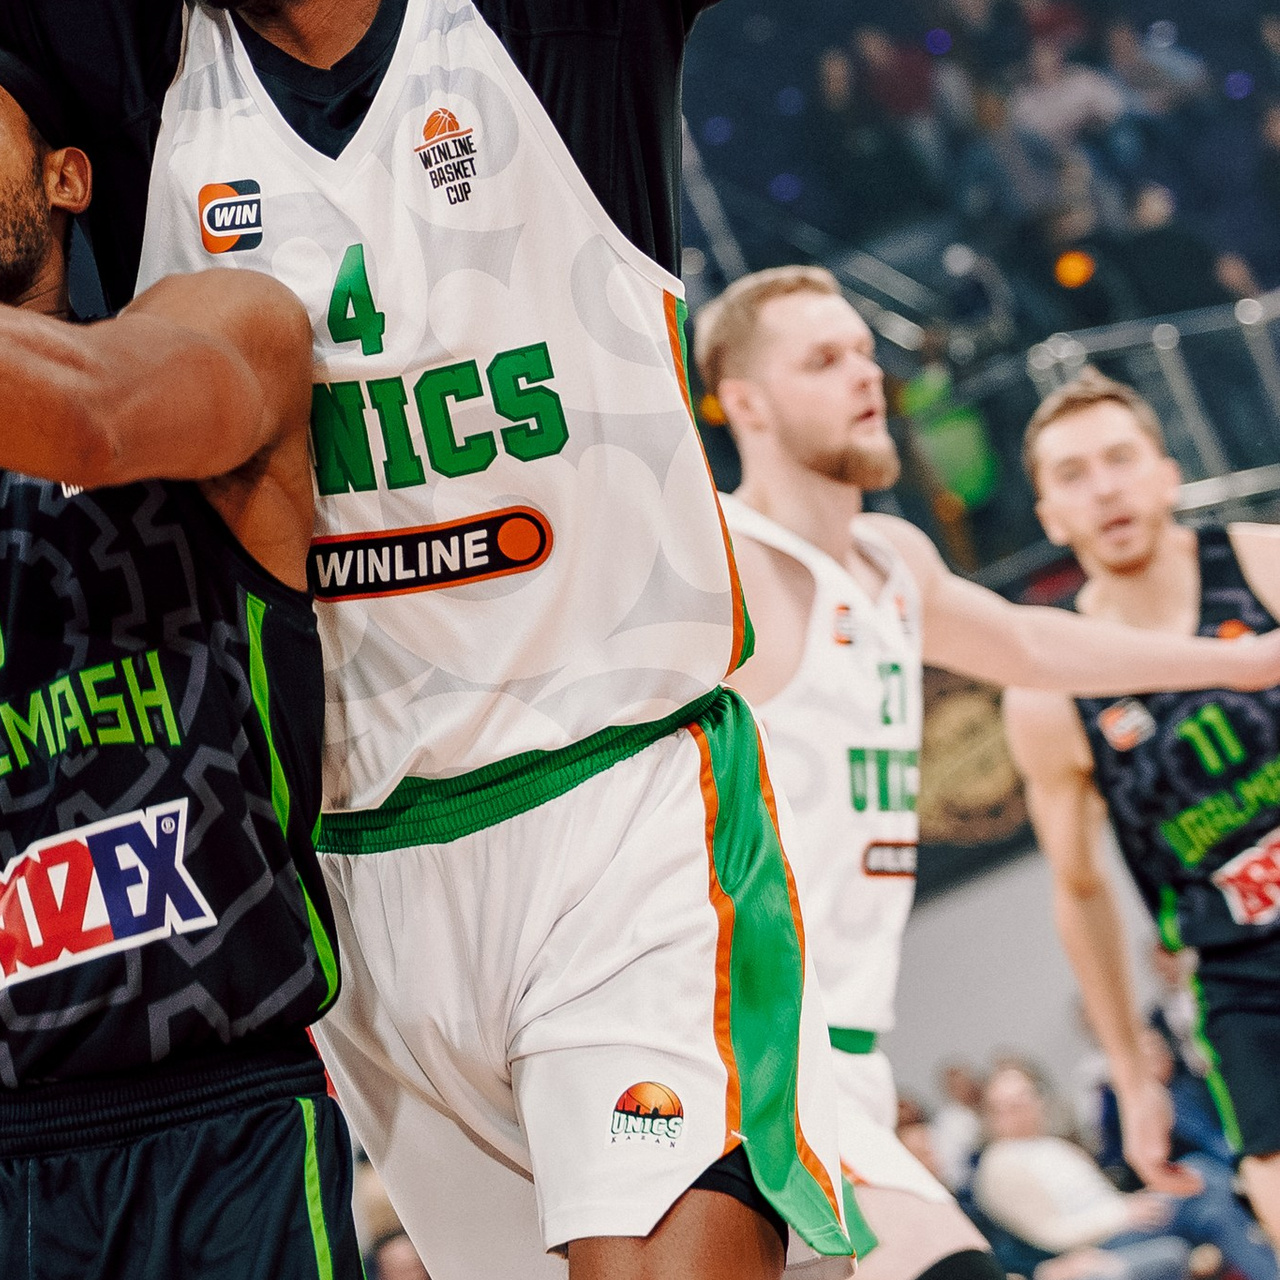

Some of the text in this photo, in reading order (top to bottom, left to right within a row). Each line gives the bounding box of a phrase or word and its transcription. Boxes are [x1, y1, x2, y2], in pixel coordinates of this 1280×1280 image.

[418, 135, 477, 170] WINLINE
[428, 157, 477, 189] BASKET
[445, 181, 472, 205] CUP
[214, 203, 258, 228] WIN
[326, 243, 386, 357] 4
[310, 340, 570, 496] NICS
[315, 528, 490, 589] WINLINE
[1176, 702, 1248, 777] 11
[610, 1110, 684, 1140] UNICS
[610, 1135, 677, 1149] KAZAN
